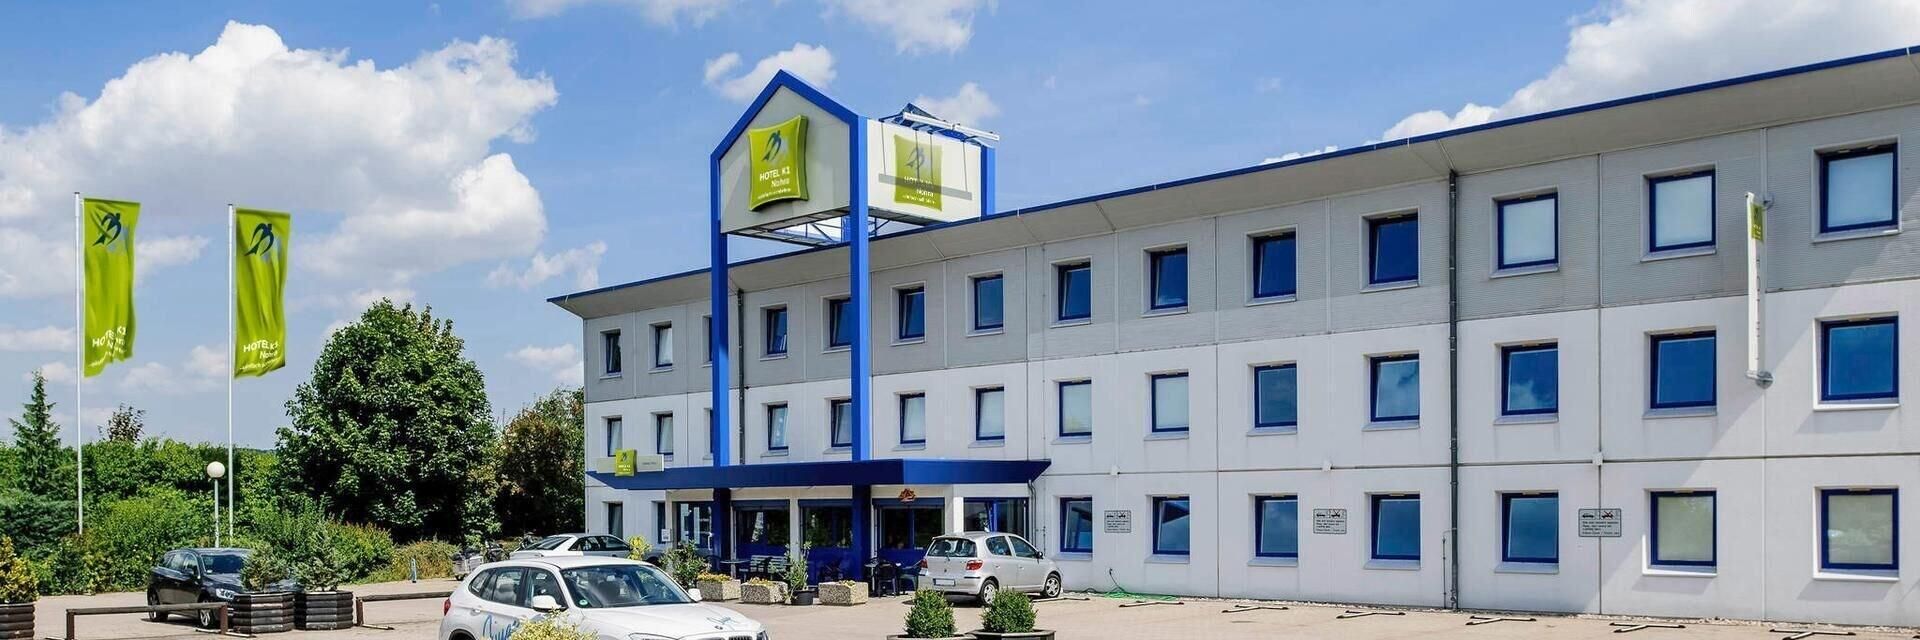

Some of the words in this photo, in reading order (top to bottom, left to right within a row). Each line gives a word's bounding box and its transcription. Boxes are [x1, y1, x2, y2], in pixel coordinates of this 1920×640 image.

[760, 169, 780, 181] HOTEL
[782, 166, 790, 174] K1
[243, 339, 269, 352] HOTEL
